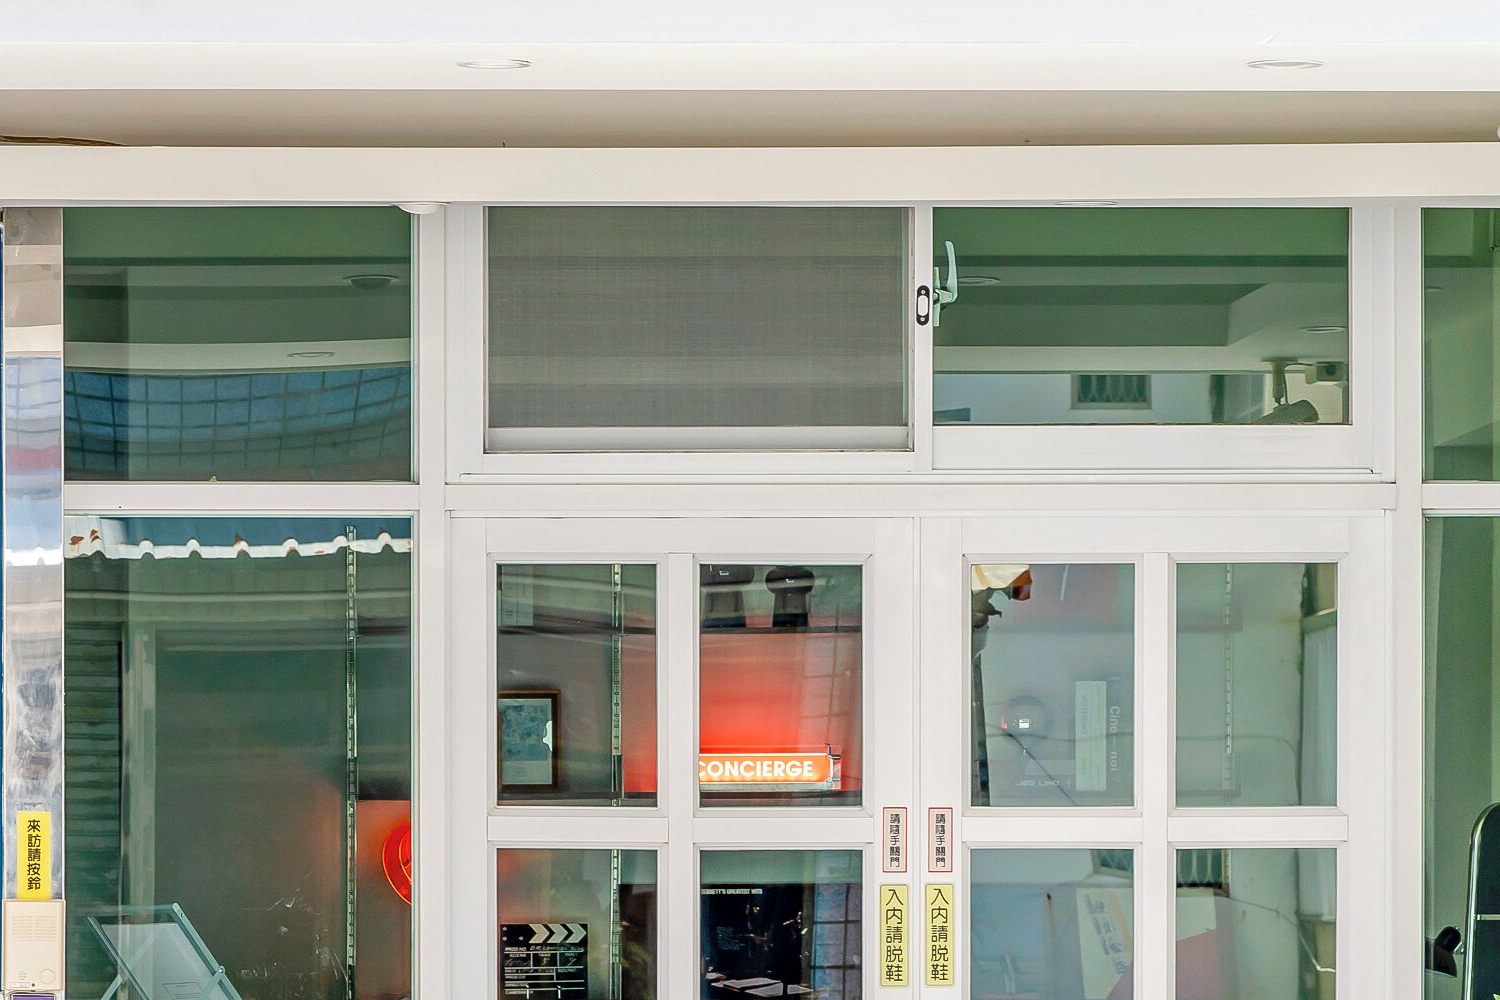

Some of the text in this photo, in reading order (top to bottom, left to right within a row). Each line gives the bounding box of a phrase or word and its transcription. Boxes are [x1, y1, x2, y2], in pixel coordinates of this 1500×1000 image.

[26, 819, 42, 891] 來訪請按鈴
